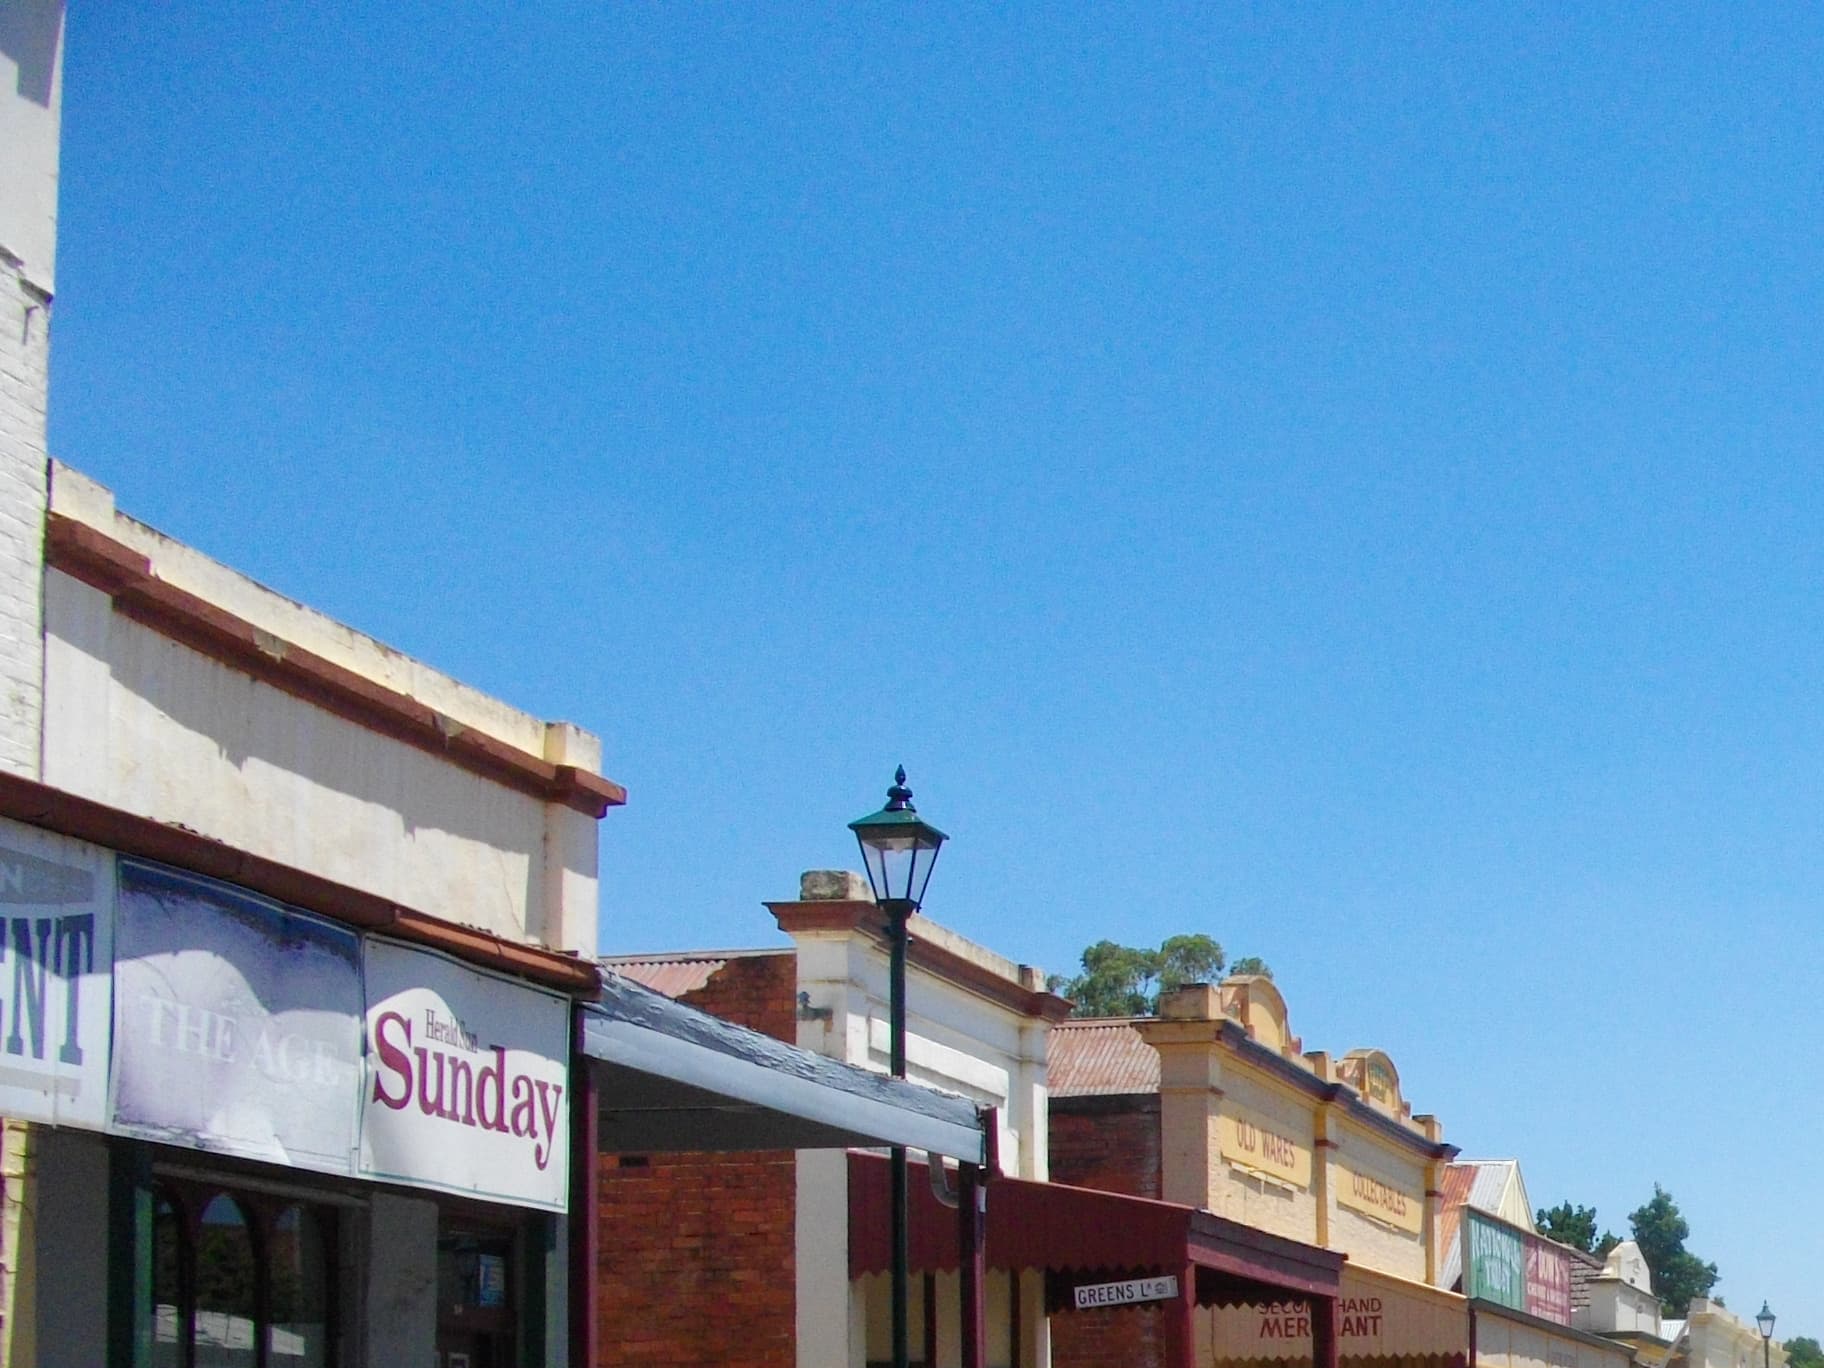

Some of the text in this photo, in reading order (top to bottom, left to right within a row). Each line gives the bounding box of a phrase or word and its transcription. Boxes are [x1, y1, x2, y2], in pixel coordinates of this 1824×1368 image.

[138, 995, 340, 1086] THE AGE
[373, 1012, 562, 1171] Sunday
[1236, 1118, 1295, 1168] OLD WARES
[1078, 1284, 1134, 1305] GREENS
[1338, 1297, 1382, 1313] HAND
[1260, 1315, 1382, 1338] MERANT
